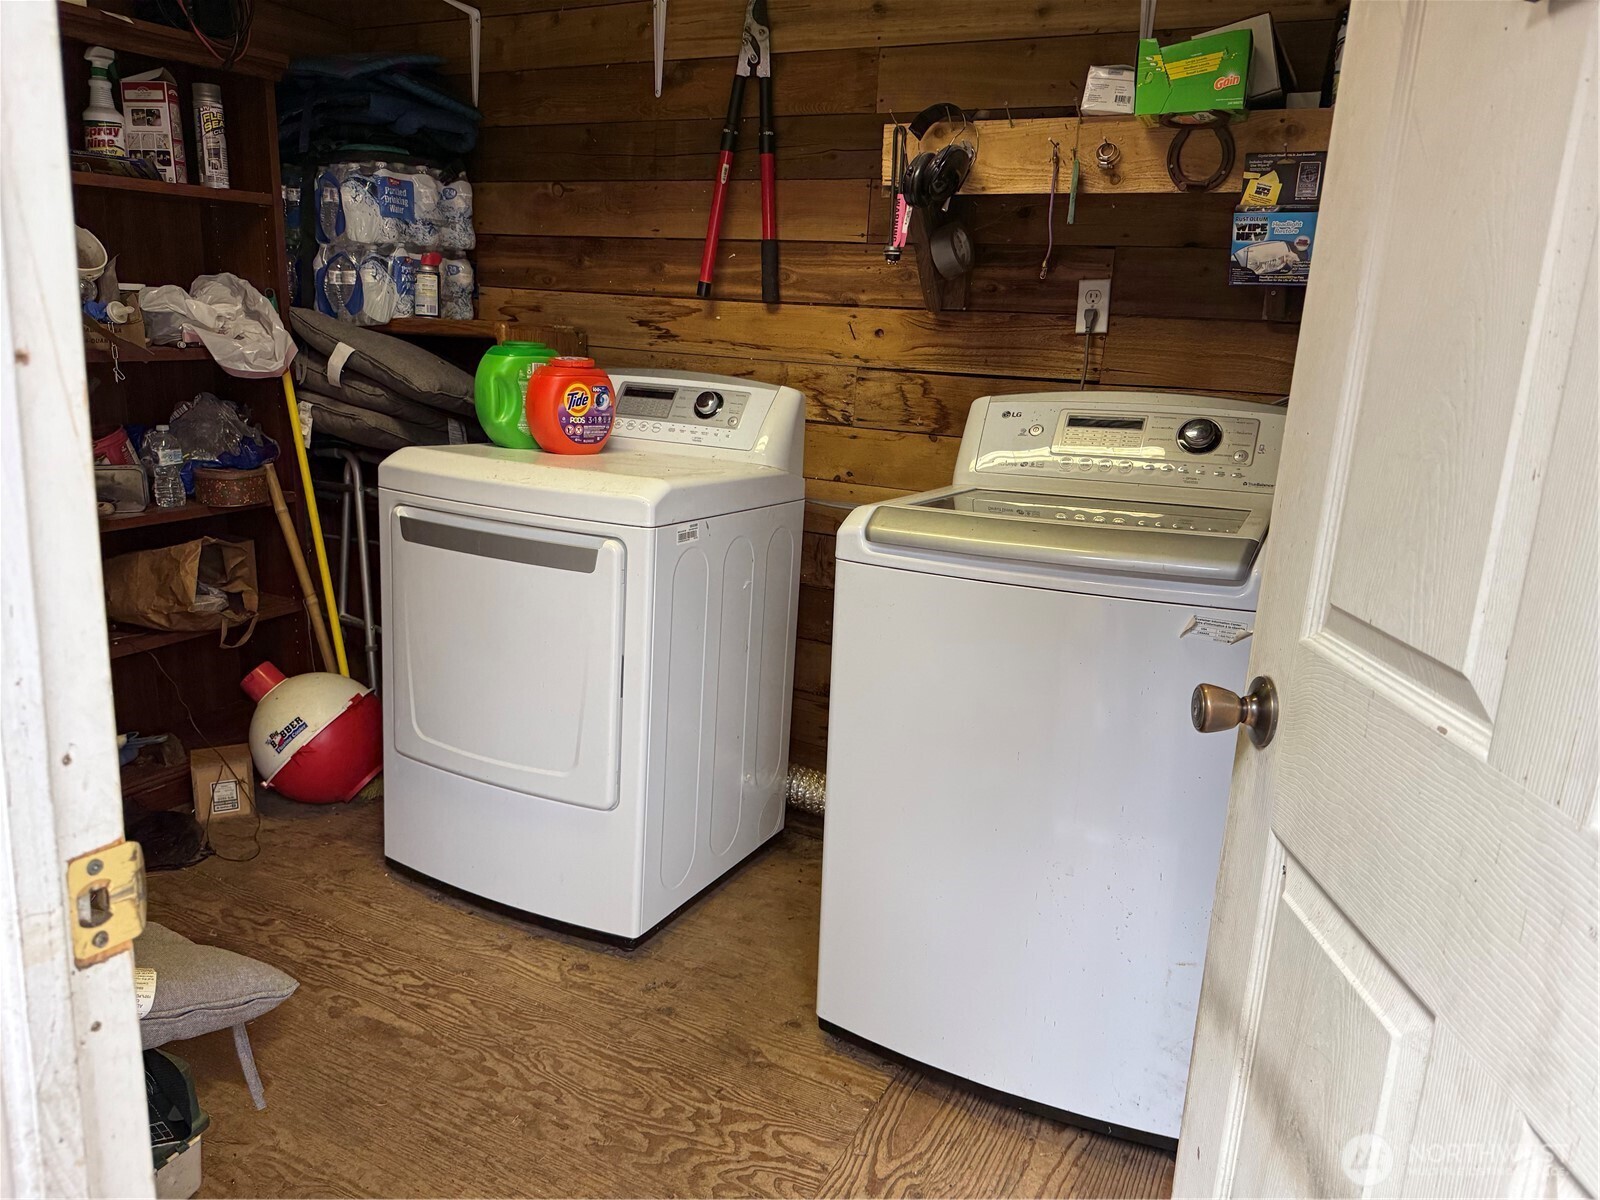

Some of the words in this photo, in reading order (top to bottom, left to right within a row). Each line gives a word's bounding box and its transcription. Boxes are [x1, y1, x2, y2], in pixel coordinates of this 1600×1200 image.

[1214, 74, 1240, 90] Gain
[202, 112, 224, 122] FLE
[204, 120, 224, 132] SEA
[84, 127, 120, 138] Spray
[88, 138, 114, 148] Nine
[893, 198, 902, 242] WARNING
[1235, 223, 1268, 231] WIPE
[1236, 232, 1268, 241] NEW
[567, 392, 589, 410] Tide
